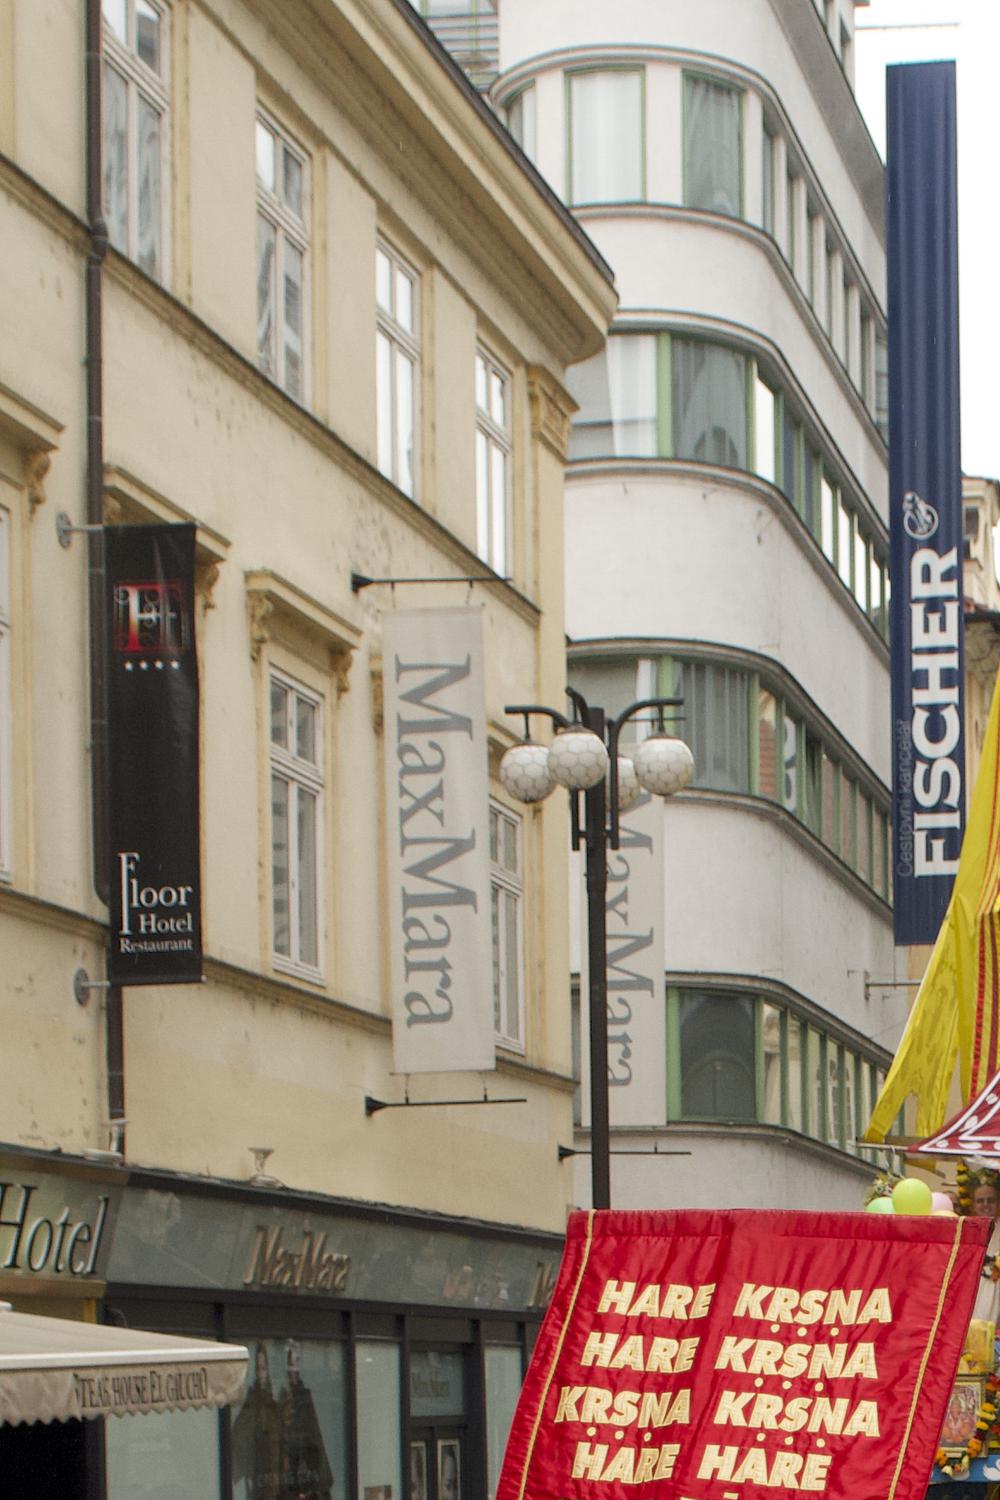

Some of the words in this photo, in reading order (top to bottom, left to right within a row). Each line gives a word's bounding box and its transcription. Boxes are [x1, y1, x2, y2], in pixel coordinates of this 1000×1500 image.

[910, 546, 960, 879] FISCHER
[395, 652, 478, 1029] MaxMara
[118, 852, 193, 935] Floor
[120, 937, 192, 953] Restaurant
[139, 912, 193, 934] Hotel
[0, 1182, 109, 1275] Hotel
[596, 1279, 717, 1321] HARE
[580, 1331, 701, 1374] HARE
[112, 1375, 148, 1406] HOUSE
[572, 1441, 677, 1486] HARE
[697, 1443, 832, 1492] HARE
